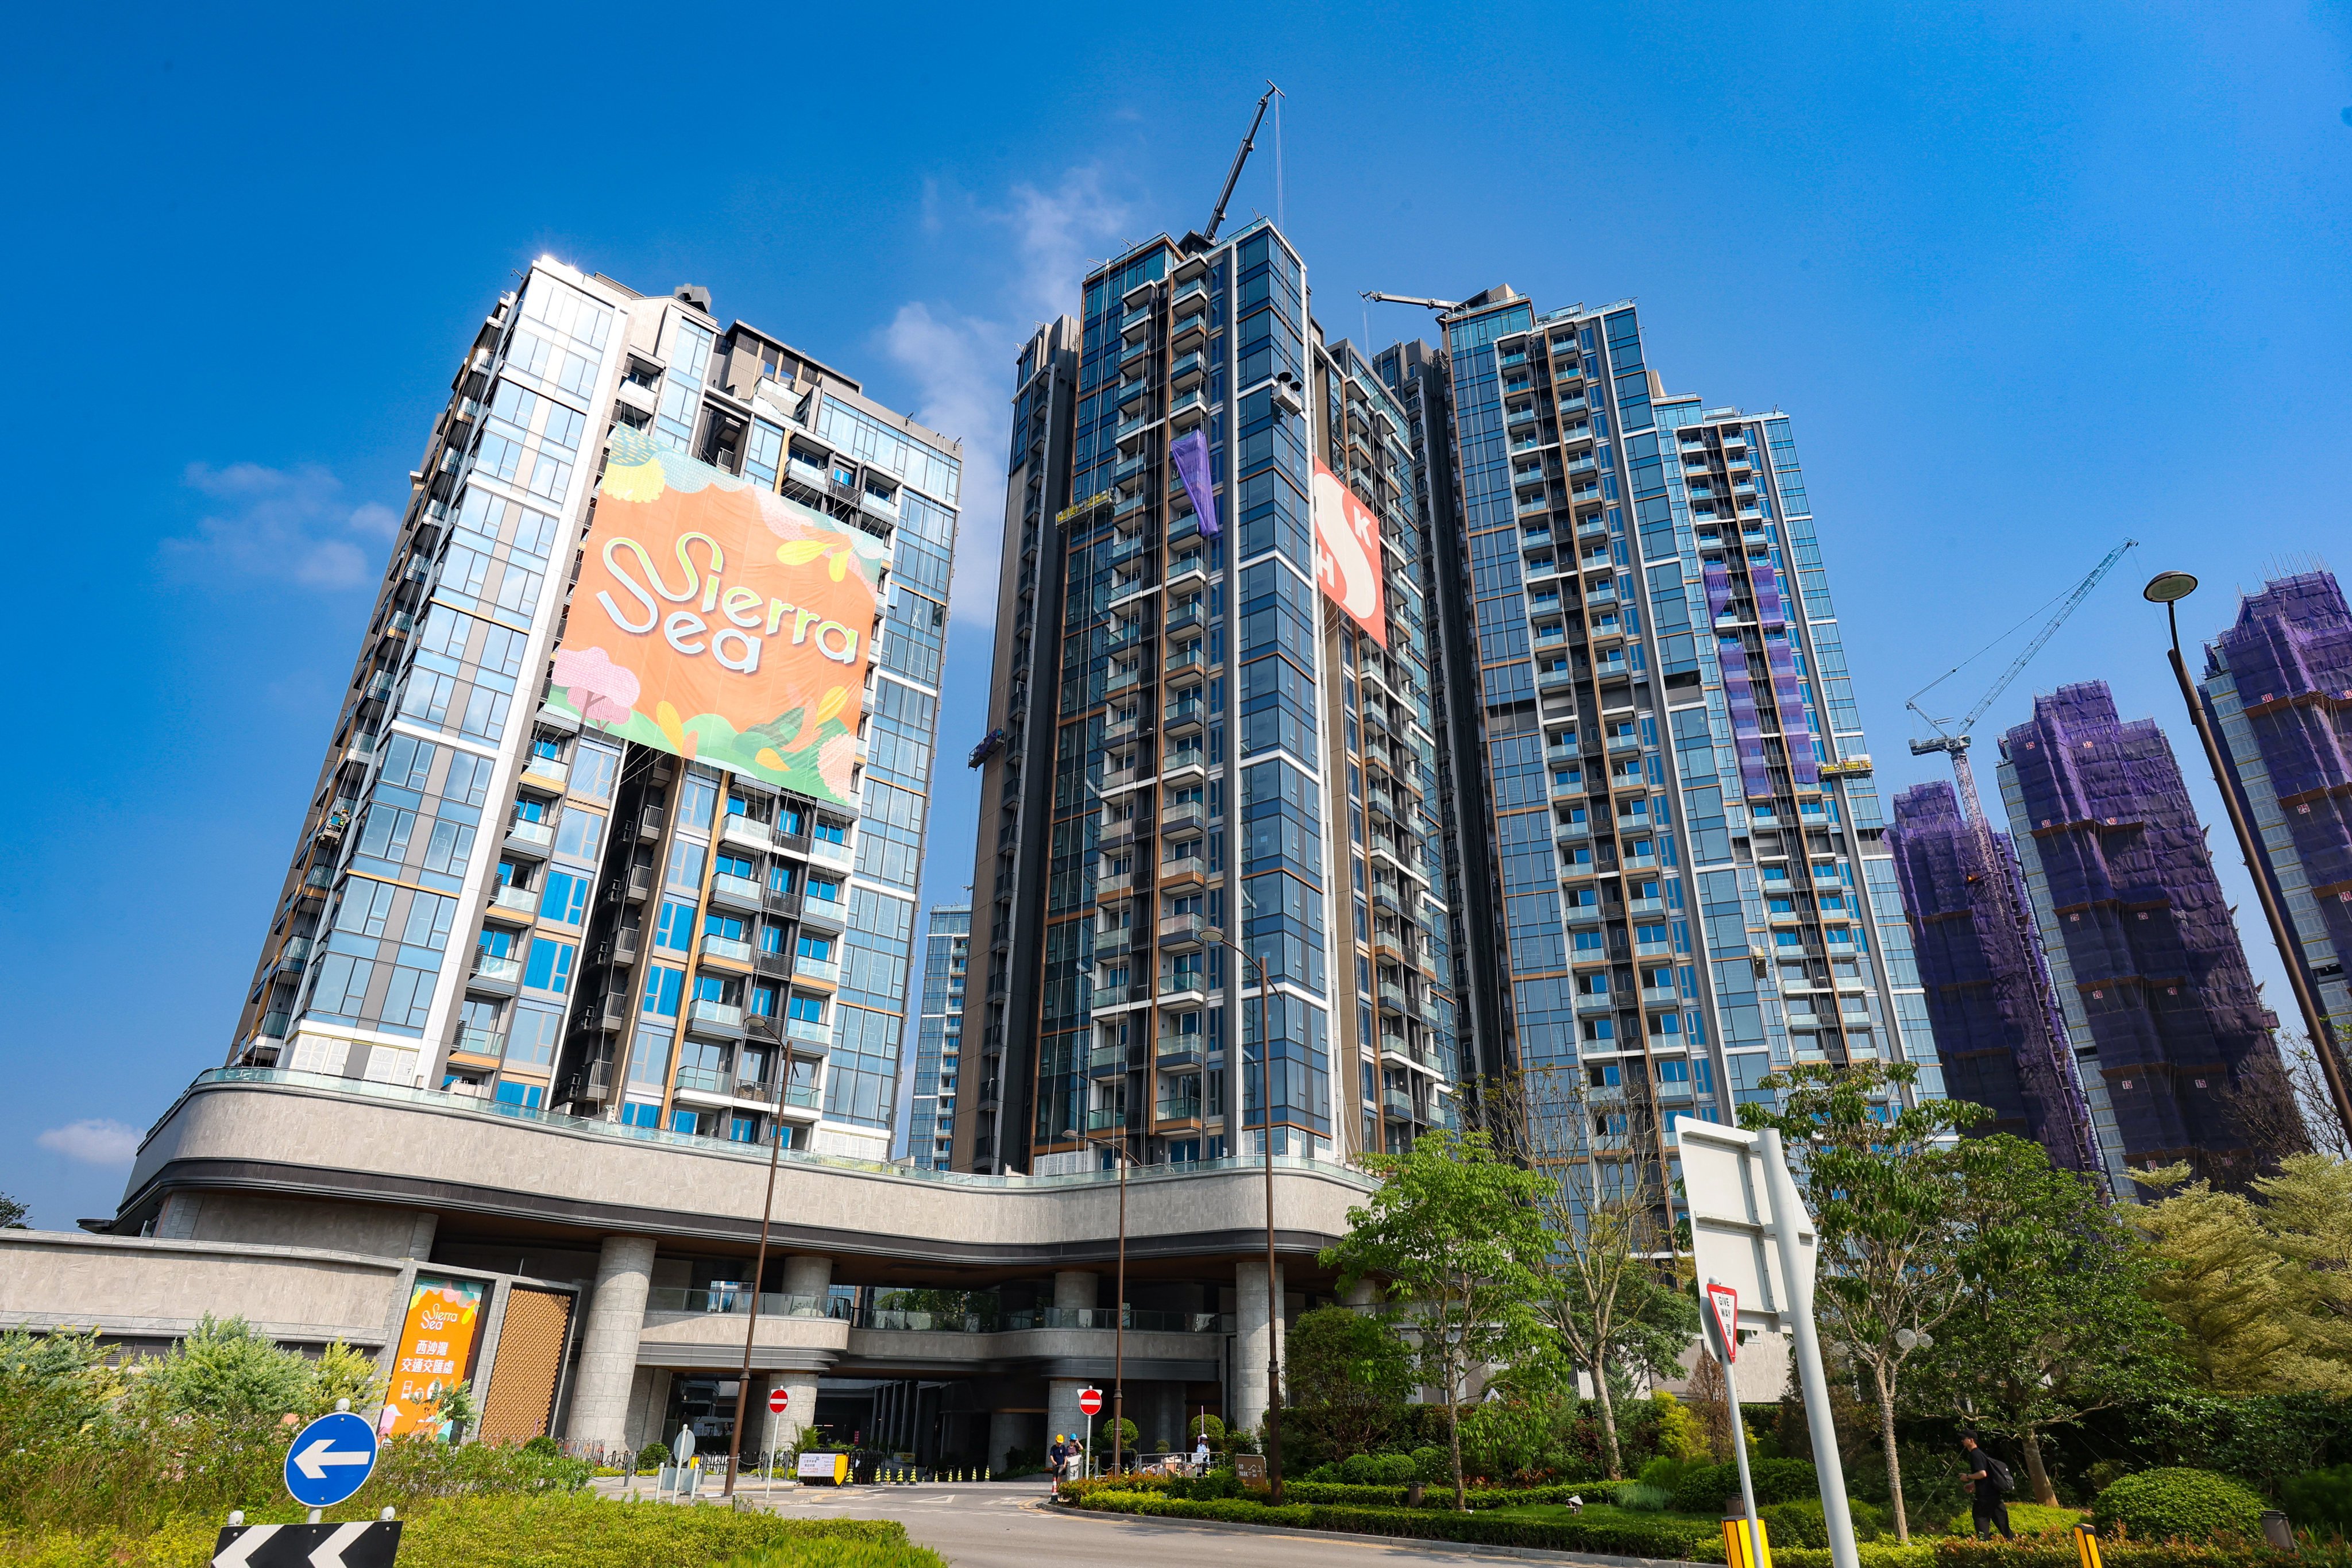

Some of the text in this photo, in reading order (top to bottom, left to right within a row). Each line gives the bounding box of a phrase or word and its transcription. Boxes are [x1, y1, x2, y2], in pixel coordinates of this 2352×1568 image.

[621, 531, 860, 665] Sierra
[596, 536, 762, 674] Sea
[2262, 694, 2273, 703] 30
[2297, 804, 2309, 813] 25
[2340, 891, 2352, 902] 20
[2147, 1161, 2156, 1169] 10
[1718, 1296, 1729, 1307] GIVE
[426, 1303, 458, 1322] Sierra
[1720, 1308, 1731, 1318] WAY
[420, 1310, 443, 1330] Sea
[416, 1340, 449, 1356] 西沙灣
[400, 1358, 454, 1374] 交通交匯處
